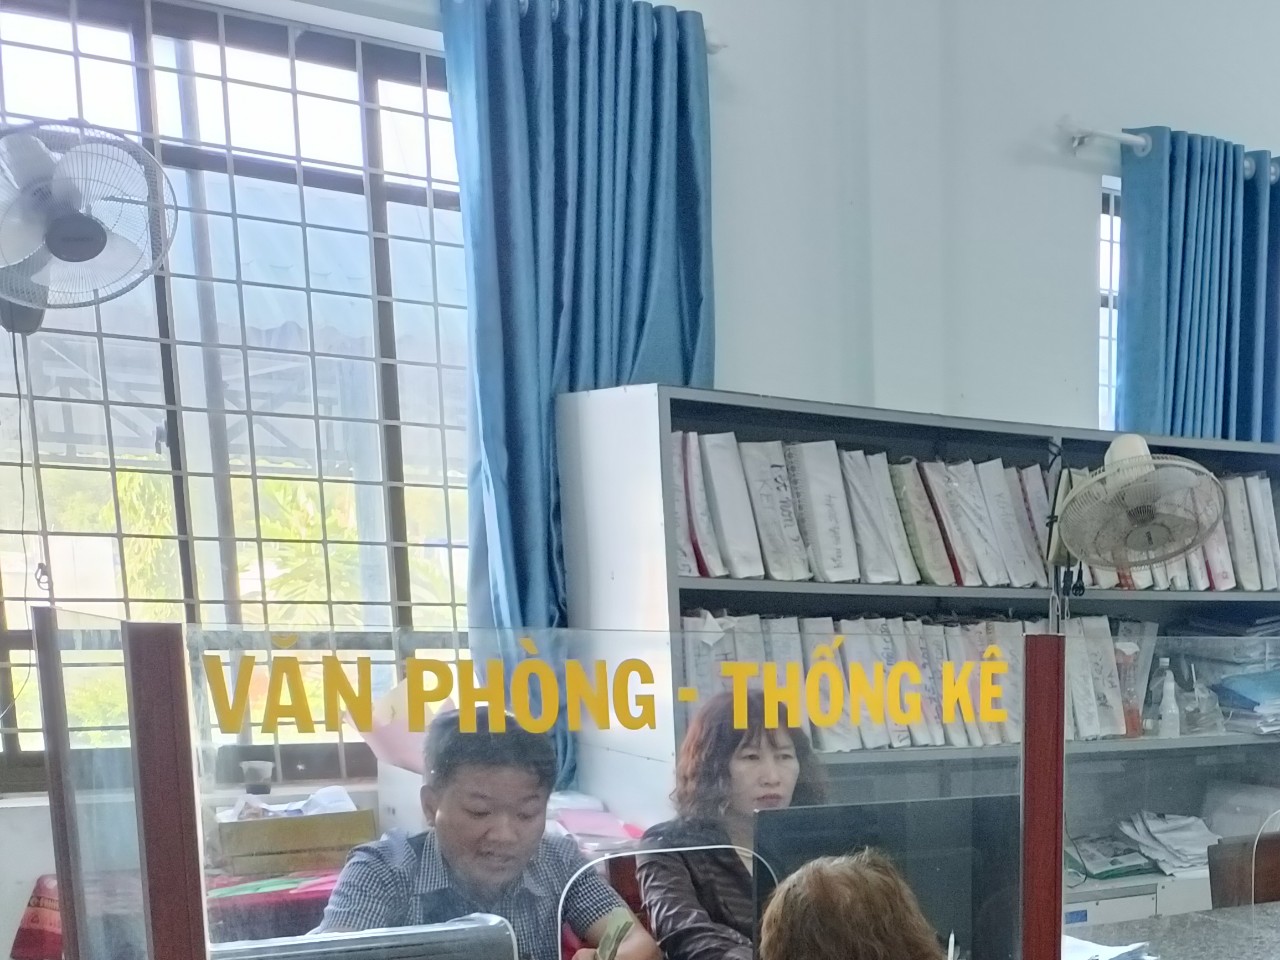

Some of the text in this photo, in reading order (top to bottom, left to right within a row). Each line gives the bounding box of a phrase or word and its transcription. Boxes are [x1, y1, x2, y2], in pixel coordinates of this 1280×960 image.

[202, 634, 372, 733] VĂN
[406, 638, 656, 733] PHÒNG
[678, 687, 697, 701] -
[721, 635, 922, 729] THỐNG
[942, 645, 1008, 724] KÊ
